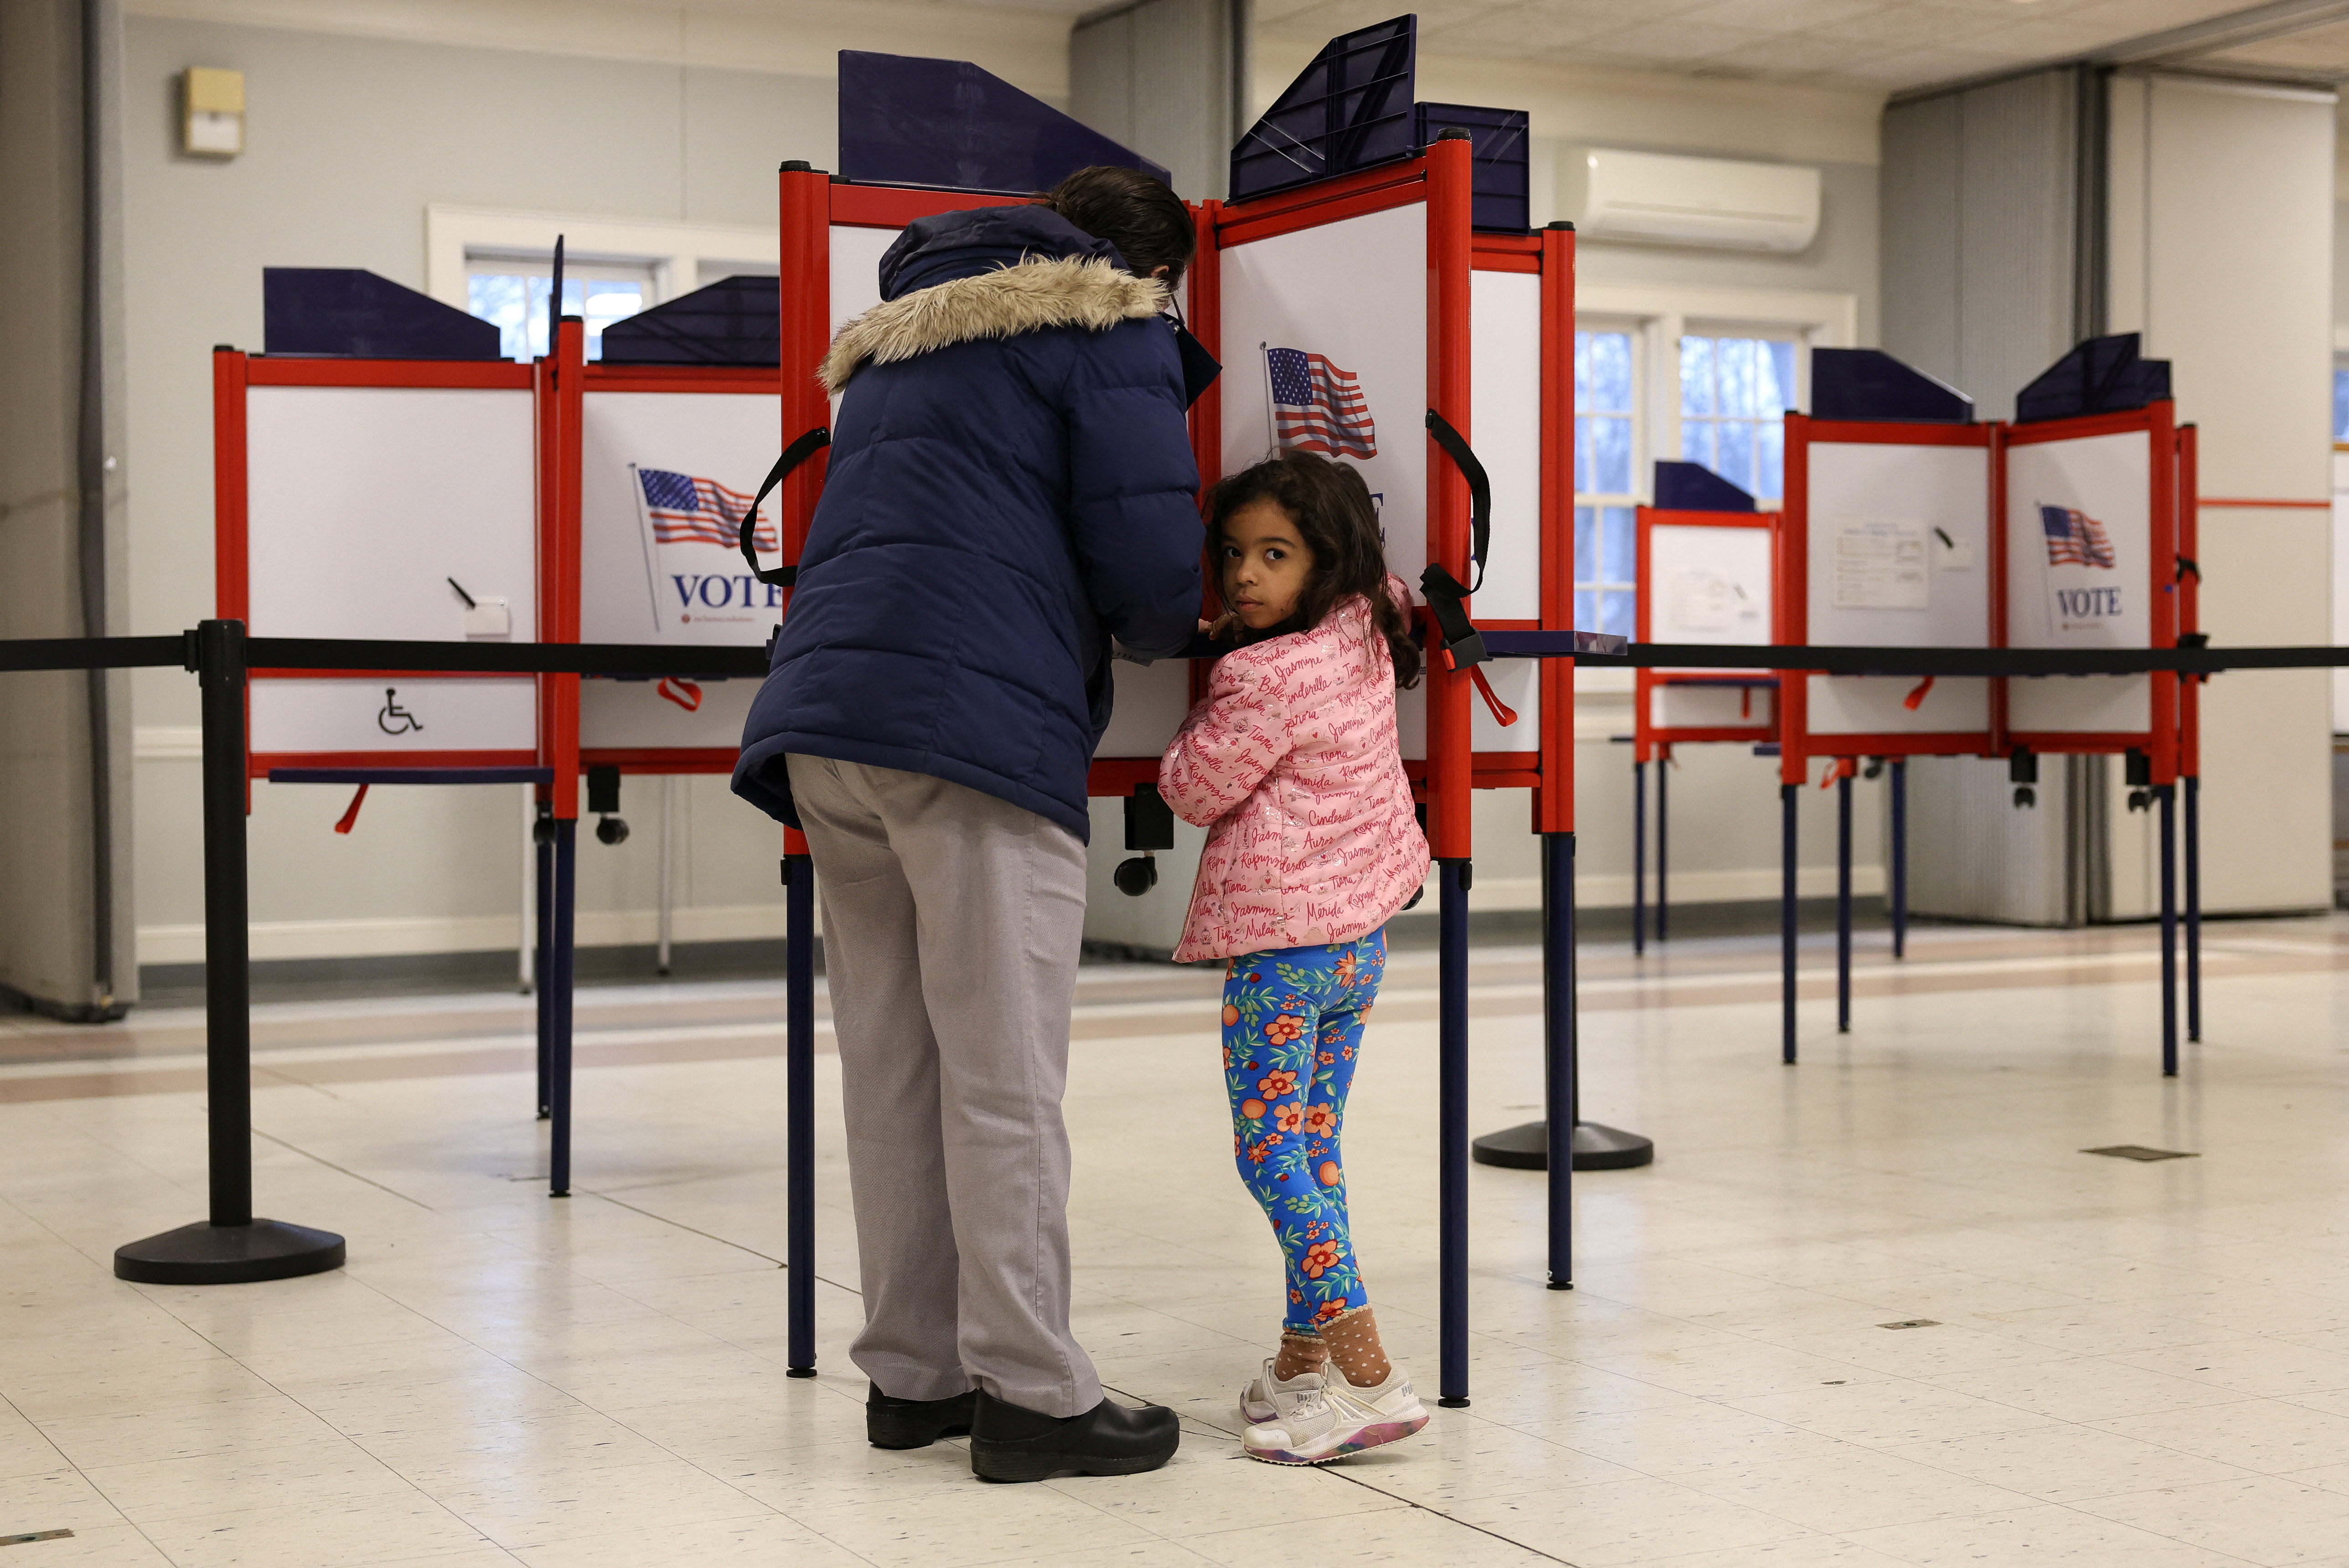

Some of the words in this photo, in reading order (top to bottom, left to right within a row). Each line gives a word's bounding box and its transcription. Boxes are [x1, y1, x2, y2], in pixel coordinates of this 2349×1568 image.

[2058, 585, 2122, 617] VOTE
[1290, 618, 1340, 648] Rapunzel
[1338, 637, 1365, 657] Aurora
[1275, 655, 1323, 685] Jasmine
[1342, 663, 1363, 680] Tiana
[1257, 675, 1285, 701] Belle
[1233, 692, 1266, 716] Mulan
[1368, 696, 1392, 719] Aurora
[1247, 725, 1274, 754] Tiana
[1329, 717, 1365, 743] Jasmine
[1316, 751, 1353, 763] Tiana
[1172, 767, 1189, 799] Belle
[1189, 760, 1235, 805] Rapunzel
[1293, 770, 1334, 789] Merida
[1337, 845, 1374, 867] Jasmine
[1329, 875, 1356, 890] Tiana
[1231, 902, 1279, 923] Jasmine
[1307, 901, 1344, 926] Merida
[1244, 918, 1279, 940] Mulan
[1327, 920, 1368, 943] Jasmine
